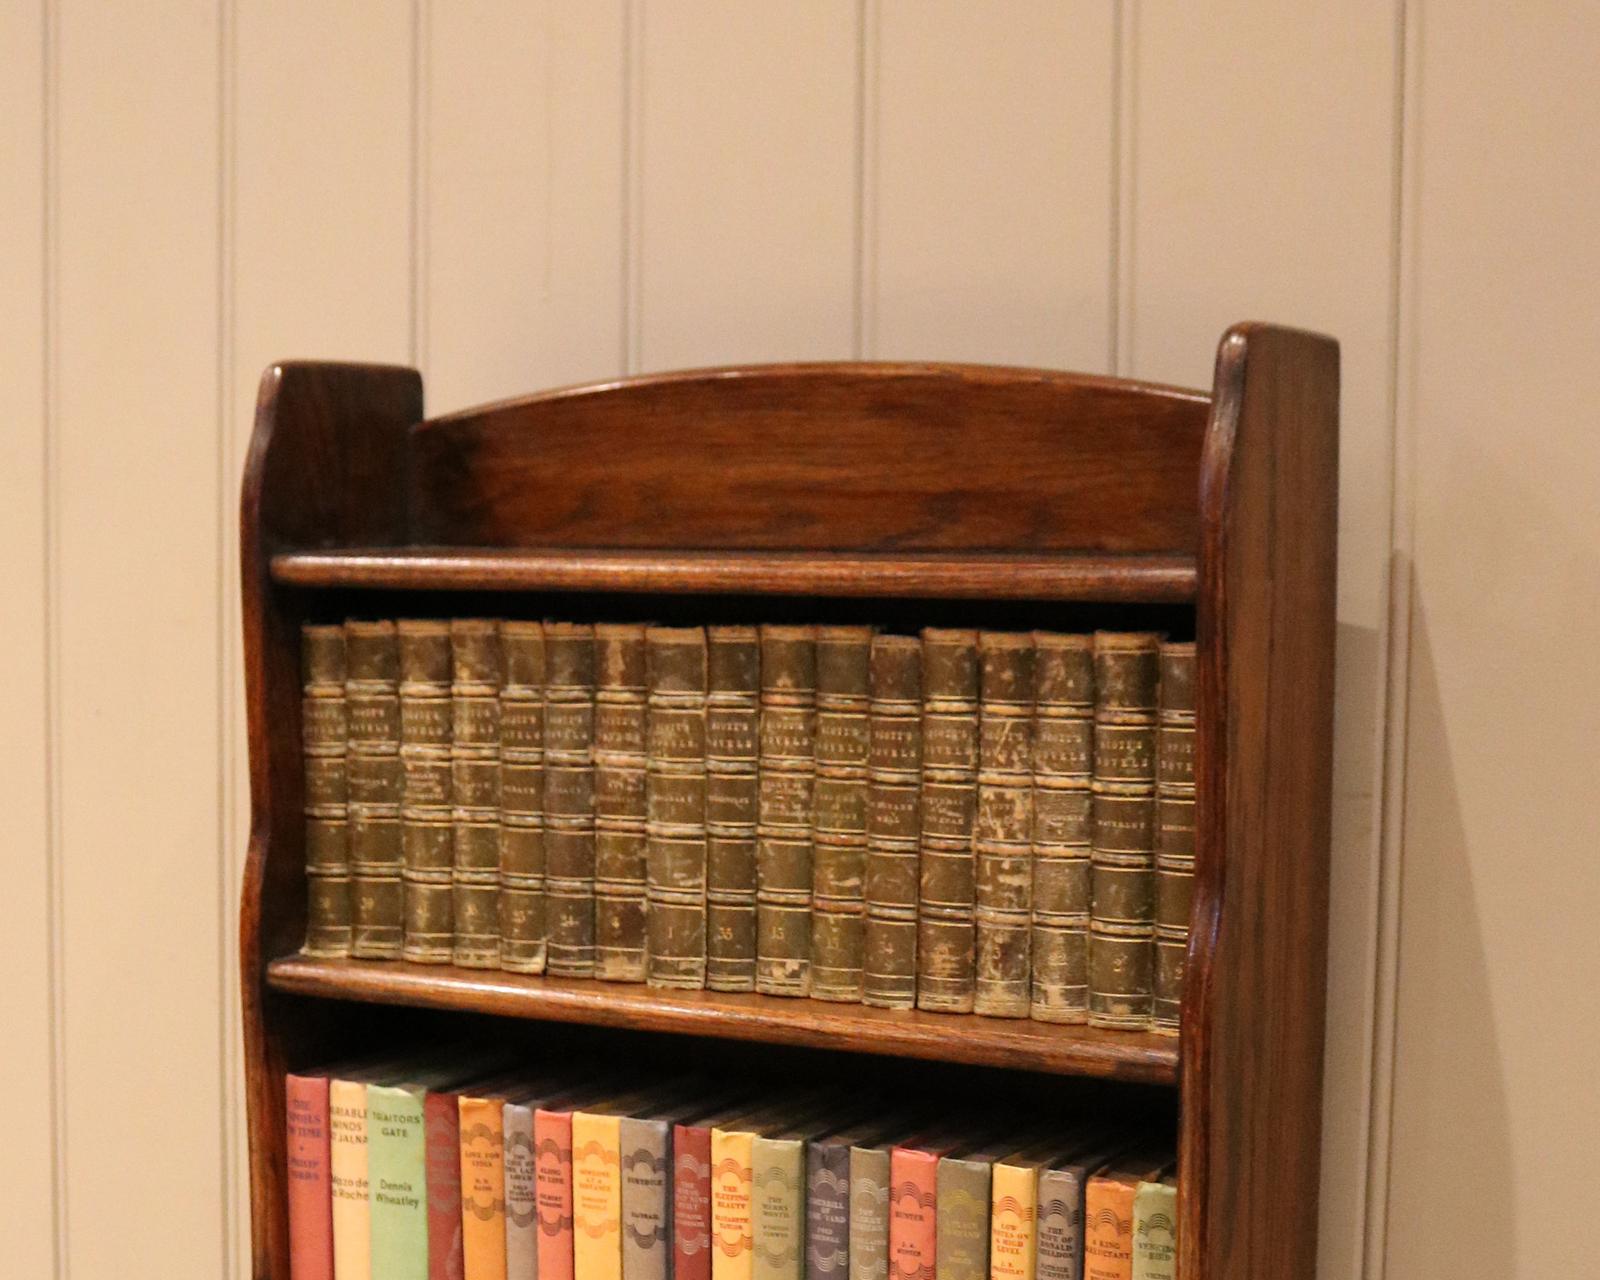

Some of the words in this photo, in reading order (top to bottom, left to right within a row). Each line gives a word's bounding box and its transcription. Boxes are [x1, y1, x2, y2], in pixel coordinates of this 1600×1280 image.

[382, 1128, 408, 1138] GATE
[380, 1179, 412, 1192] Dennis
[376, 1192, 420, 1209] Wheatley
[718, 1201, 746, 1210] BEAUTY
[1047, 1227, 1064, 1236] THE
[1040, 1232, 1058, 1242] WIFE
[1100, 1241, 1120, 1250] KING
